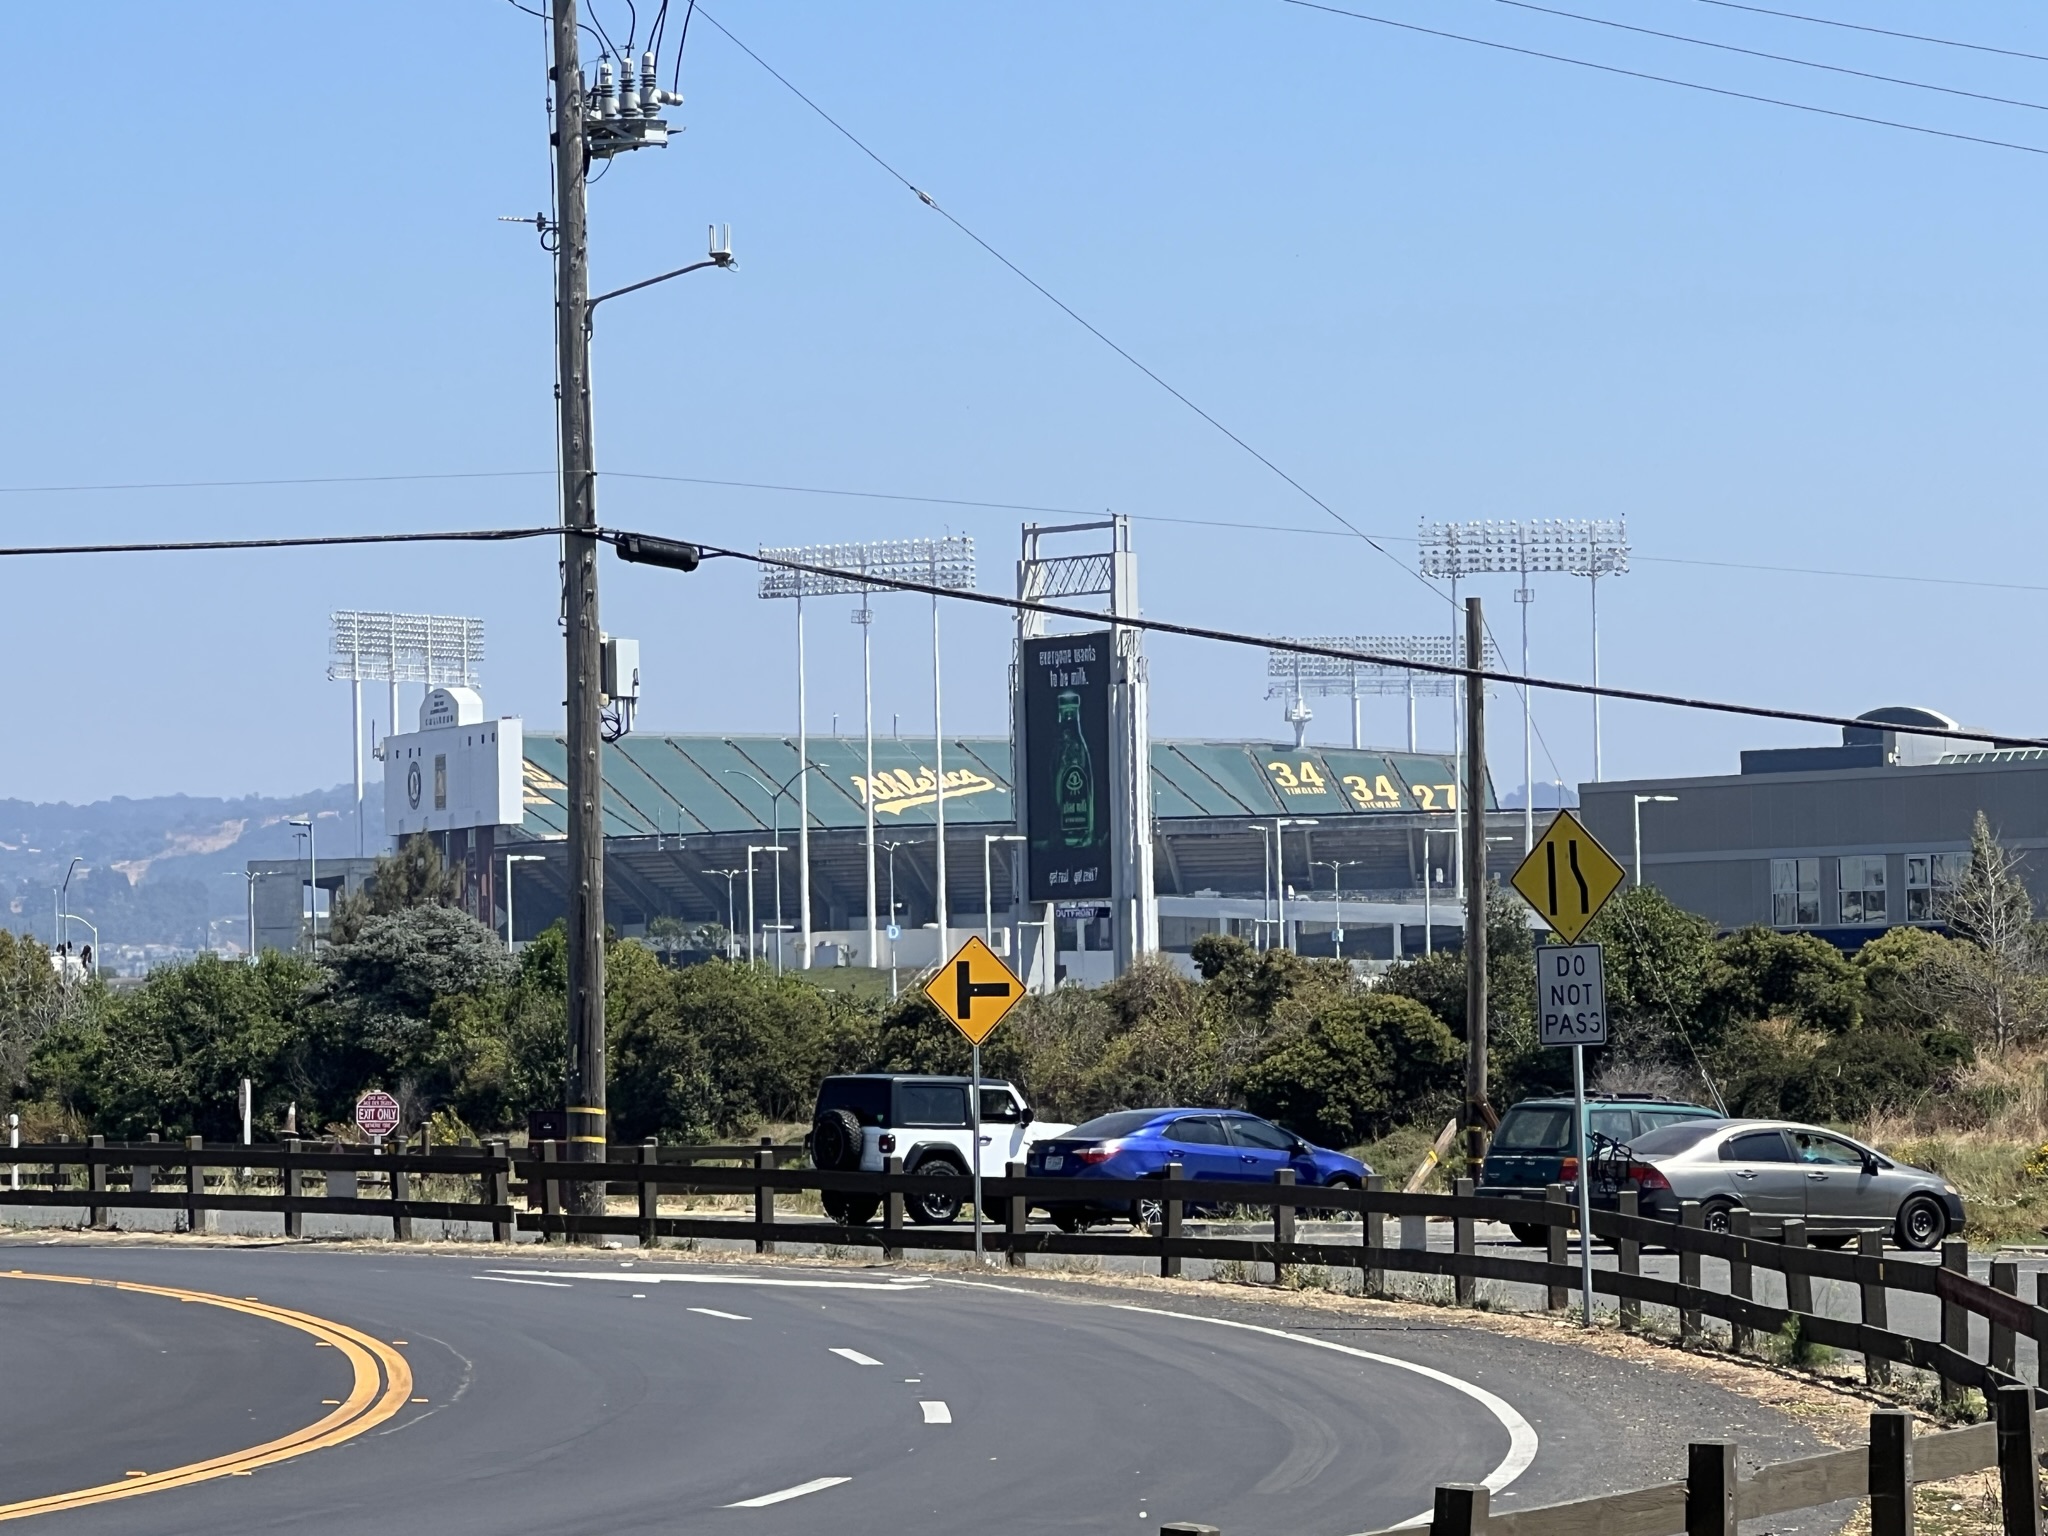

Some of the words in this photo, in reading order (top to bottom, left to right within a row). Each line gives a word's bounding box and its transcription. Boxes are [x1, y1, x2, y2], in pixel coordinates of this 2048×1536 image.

[1268, 761, 1326, 787] 34
[1343, 775, 1400, 801] 34
[1412, 784, 1457, 810] 27
[888, 926, 899, 939] D
[1556, 954, 1585, 977] DO
[1551, 984, 1592, 1006] NOT
[1545, 1012, 1600, 1035] PASS
[359, 1108, 375, 1120] EXIT
[377, 1108, 396, 1120] ONLY
